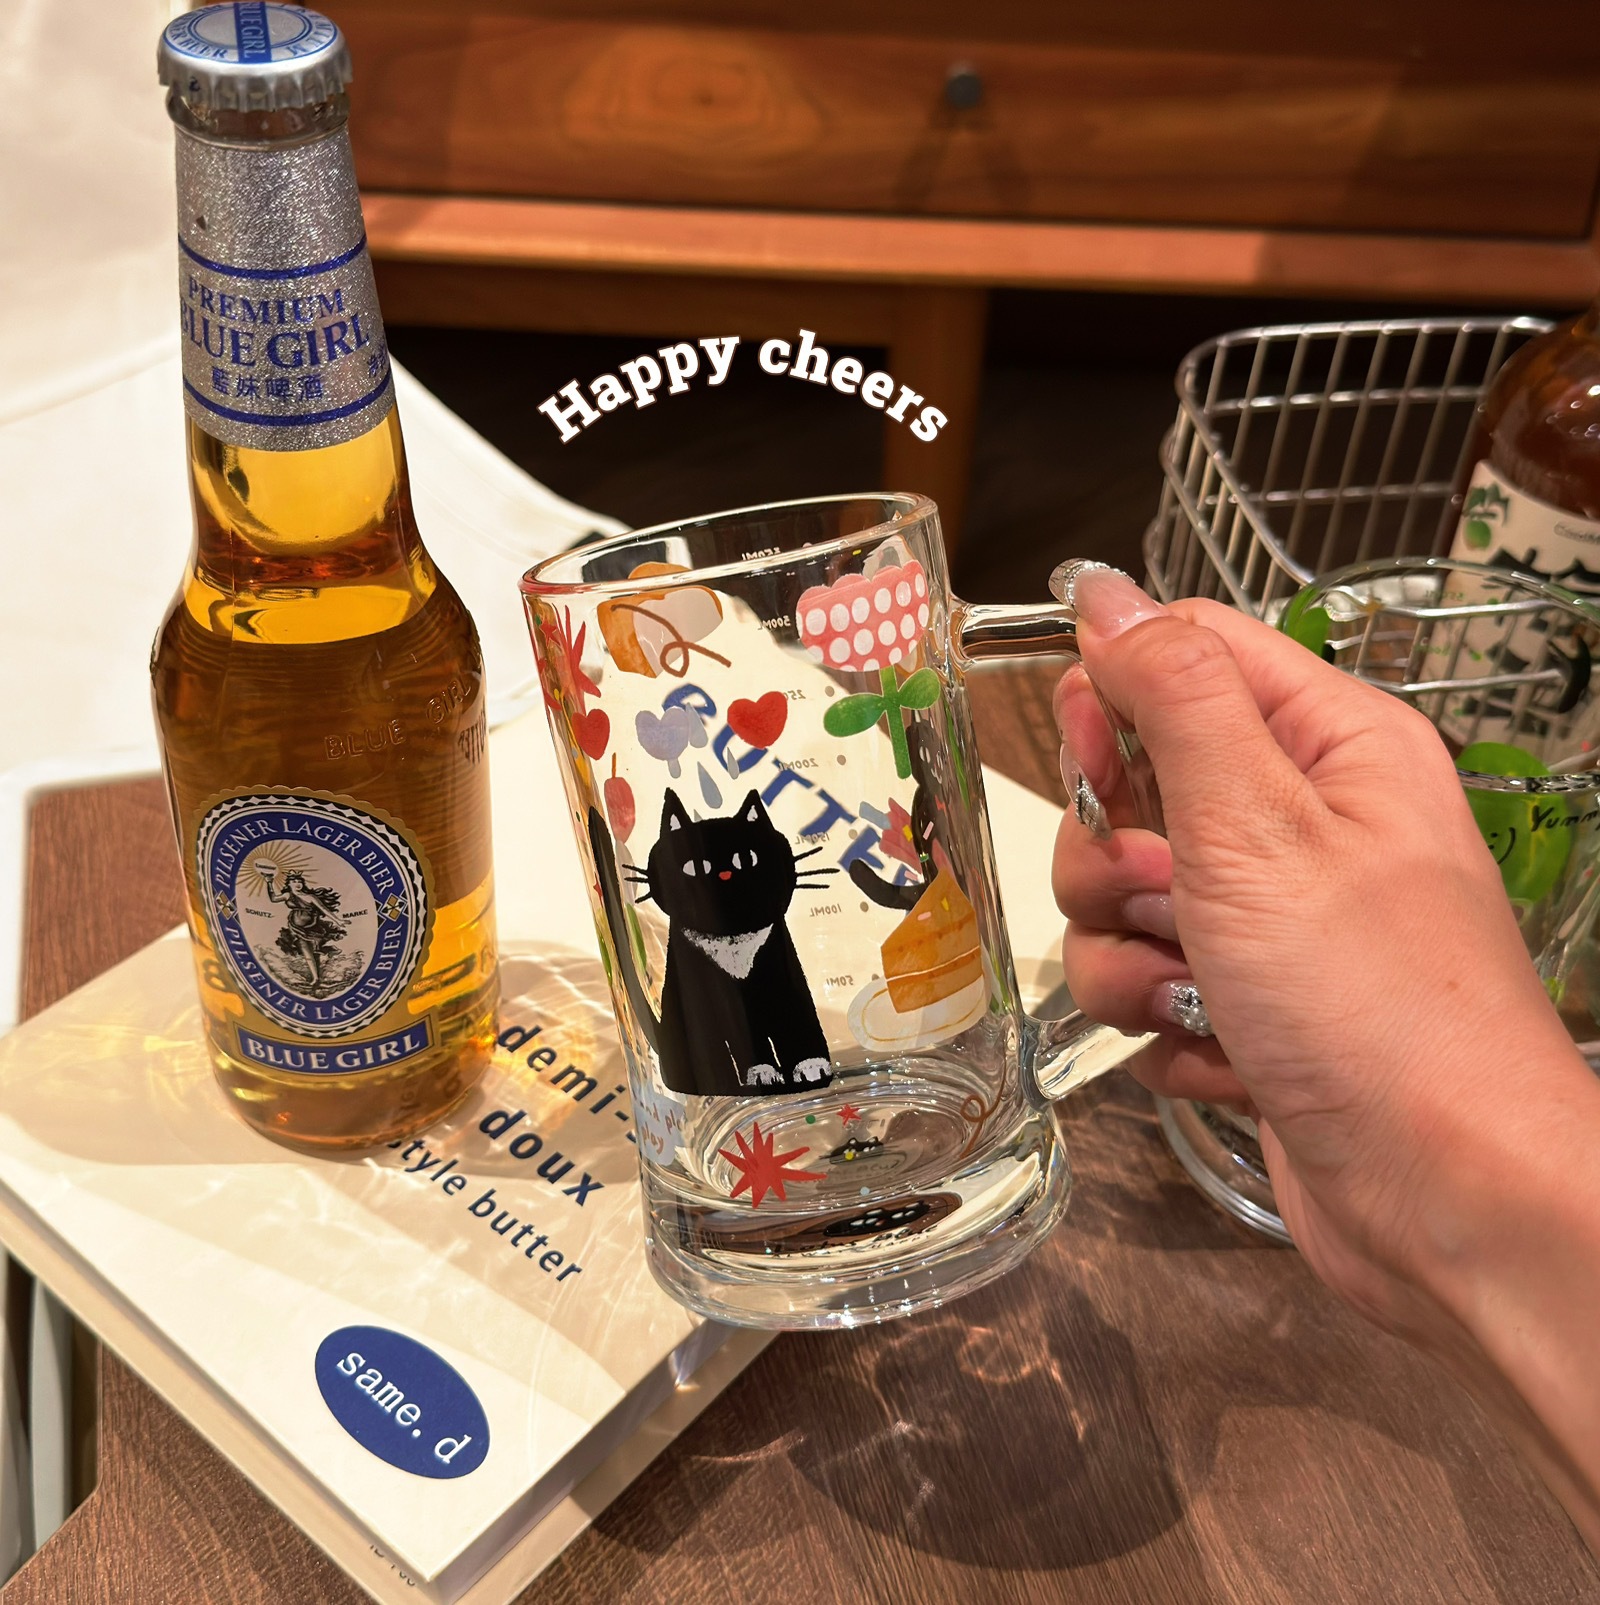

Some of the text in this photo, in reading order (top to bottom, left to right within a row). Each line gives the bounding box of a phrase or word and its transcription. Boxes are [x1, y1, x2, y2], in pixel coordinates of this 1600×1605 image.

[181, 300, 256, 367] BLUE
[267, 313, 370, 368] GIRL
[188, 275, 345, 325] PREMIUM
[211, 366, 324, 401] 藍妹啤酒
[324, 719, 407, 760] BLUE
[426, 675, 472, 724] GIRL
[215, 818, 396, 895] PILSENER LAGER BIER
[342, 908, 369, 919] MARKE
[225, 923, 403, 1021] PILSENER LAGER BIER
[247, 1032, 421, 1070] BLUE GIRL
[478, 1109, 605, 1208] doux
[387, 1137, 583, 1282] tyle butter
